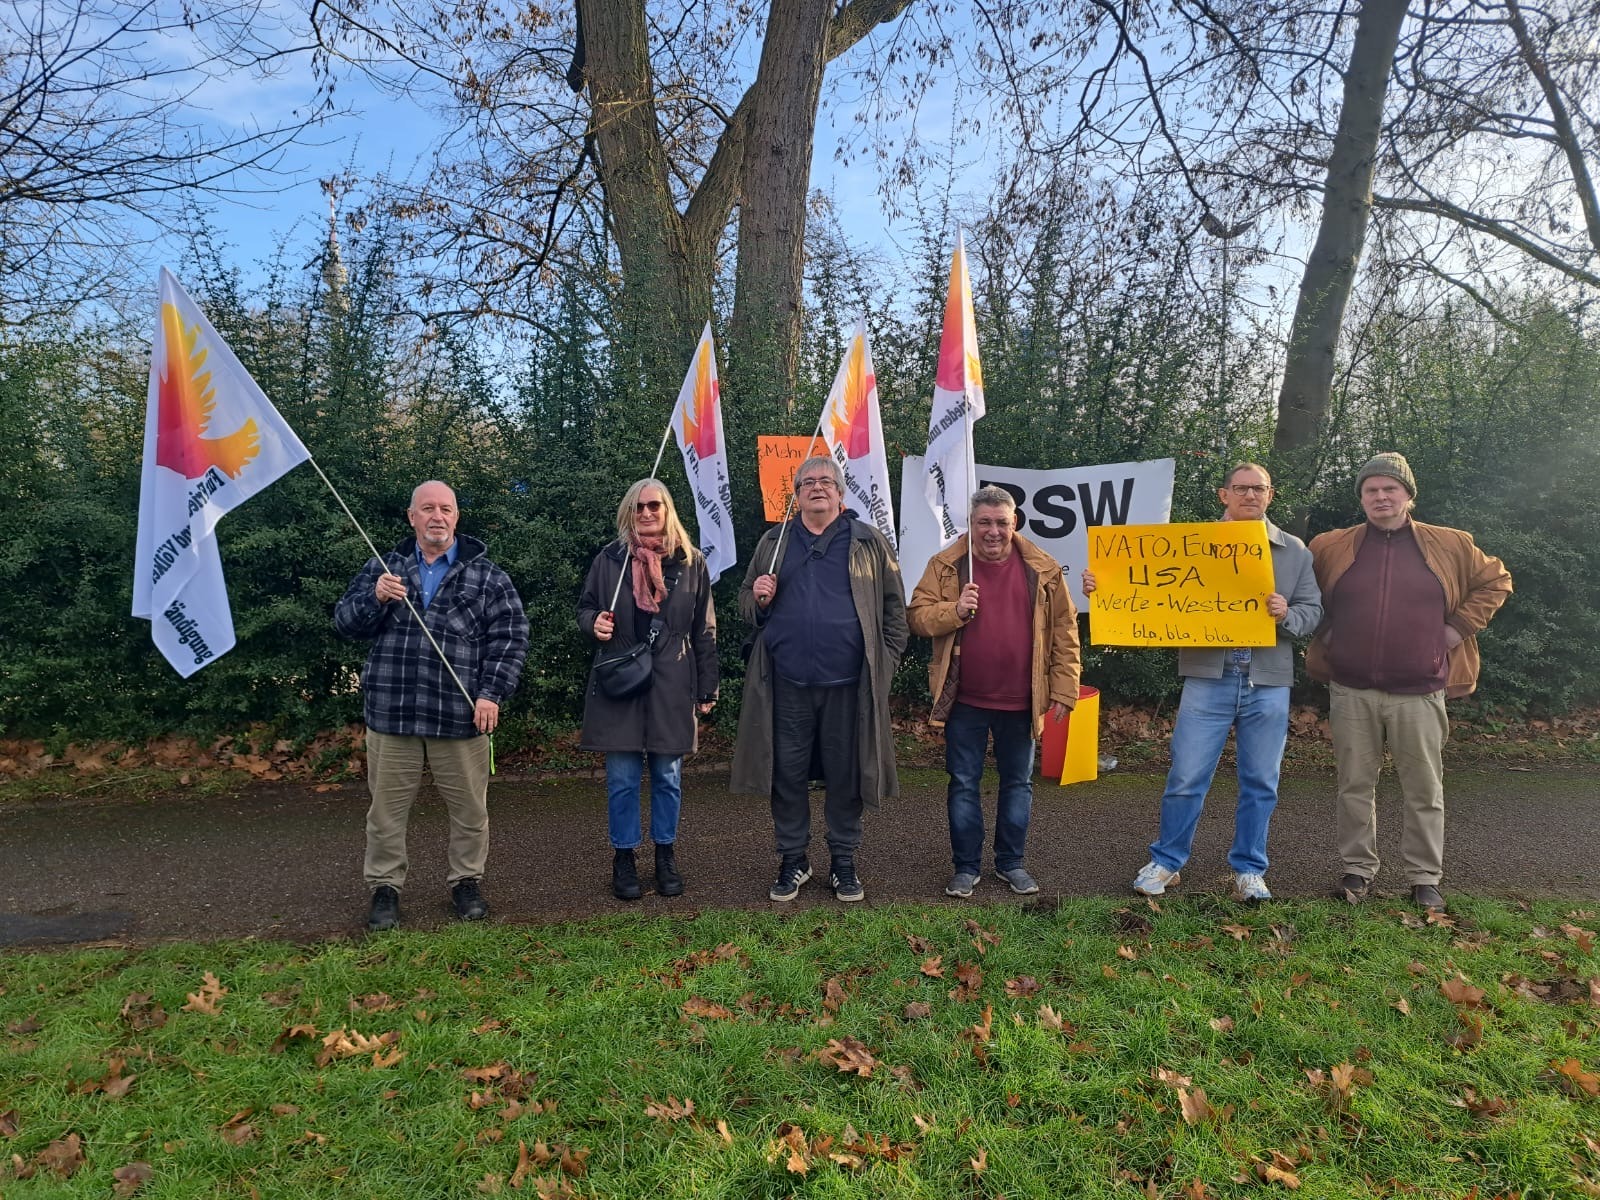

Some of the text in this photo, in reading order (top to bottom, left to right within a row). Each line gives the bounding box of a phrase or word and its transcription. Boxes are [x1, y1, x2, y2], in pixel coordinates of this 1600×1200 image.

[1095, 533, 1264, 575] NATO, Europa
[1128, 564, 1205, 588] USA
